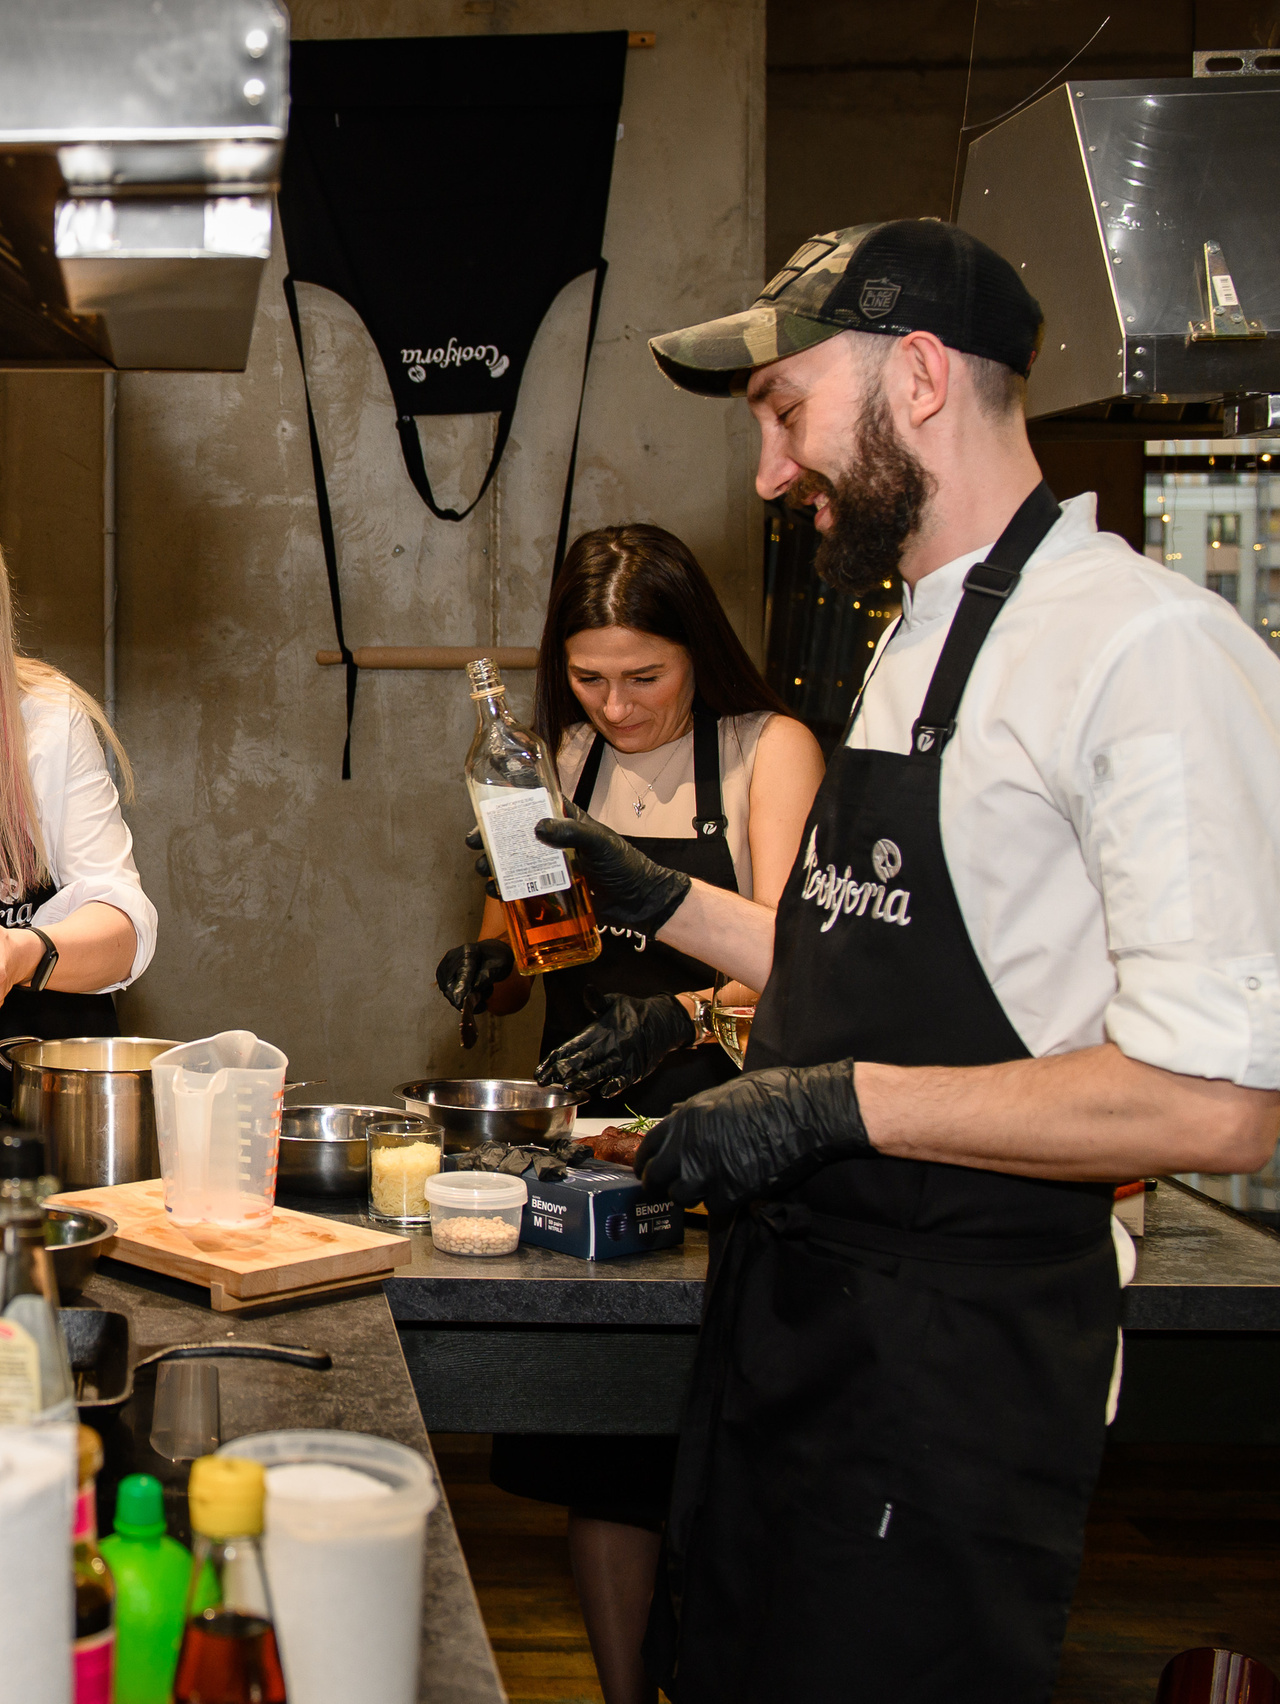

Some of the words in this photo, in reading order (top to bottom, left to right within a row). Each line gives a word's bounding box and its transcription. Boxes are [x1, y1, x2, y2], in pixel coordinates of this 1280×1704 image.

[863, 296, 891, 307] LINE
[401, 337, 499, 383] Cookforia
[531, 1198, 563, 1215] BENOVY
[635, 1202, 670, 1217] BENOVY
[533, 1215, 543, 1228] M
[638, 1222, 648, 1234] M
